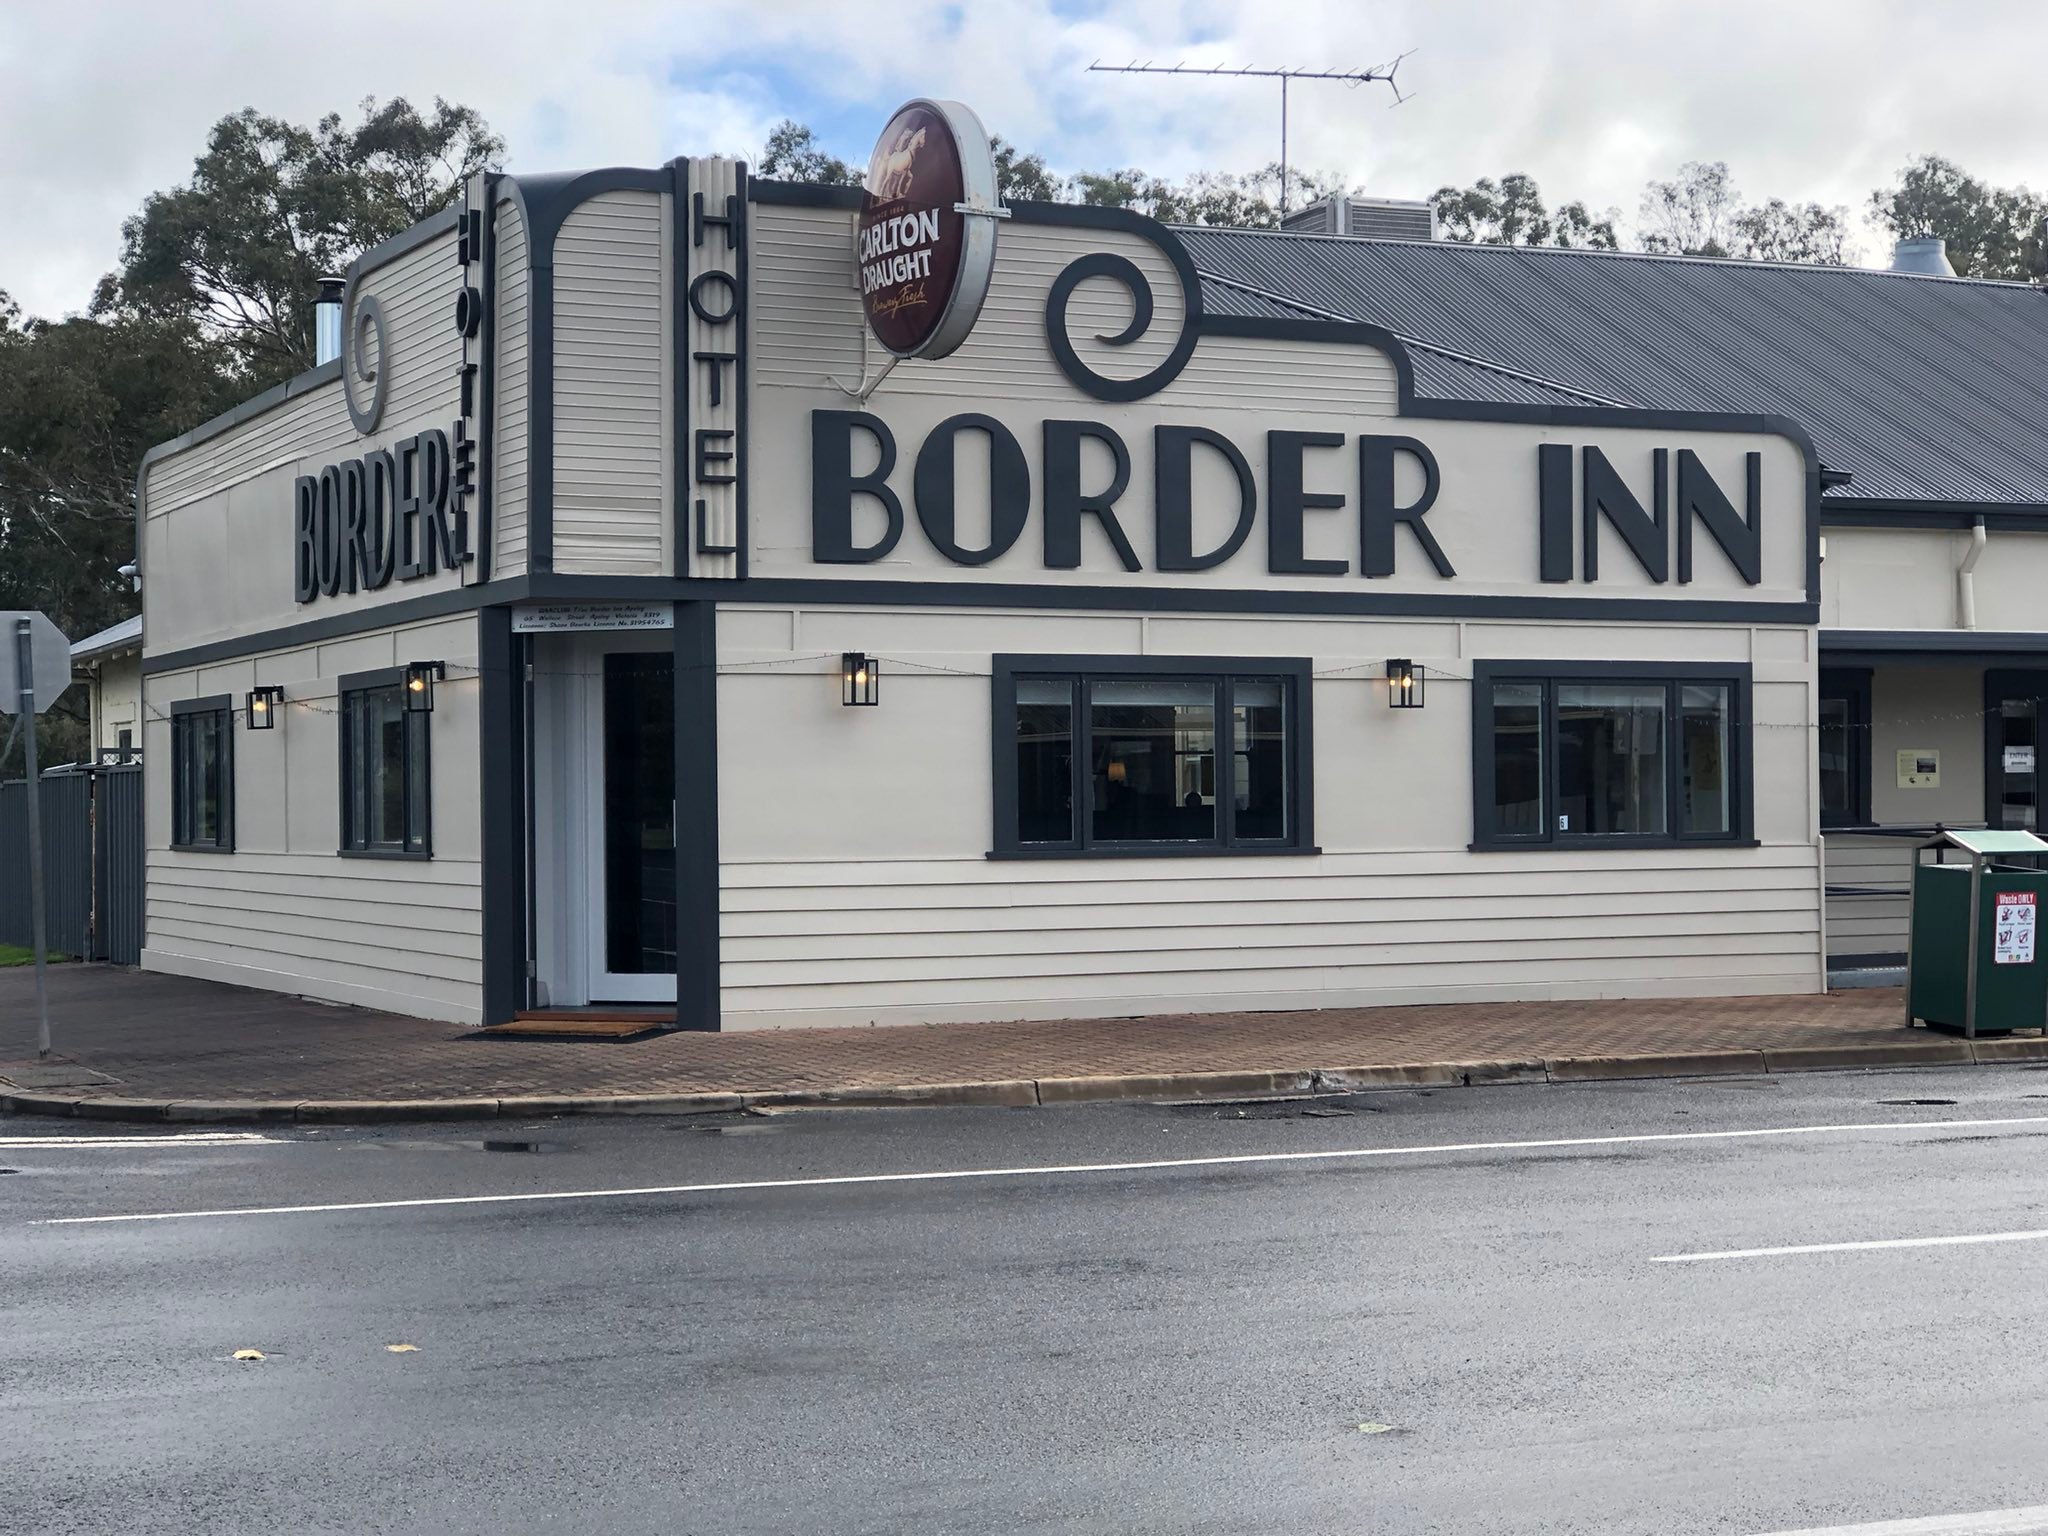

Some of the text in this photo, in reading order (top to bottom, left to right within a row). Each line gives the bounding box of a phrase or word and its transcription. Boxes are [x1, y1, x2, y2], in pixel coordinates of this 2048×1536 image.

[858, 207, 941, 264] CARLTON
[863, 249, 932, 295] DRAUGHT
[688, 191, 740, 555] HOTEL
[295, 429, 458, 603] BORDER
[811, 409, 1762, 585] BORDER INN
[1999, 893, 2034, 905] Waste ONLY
